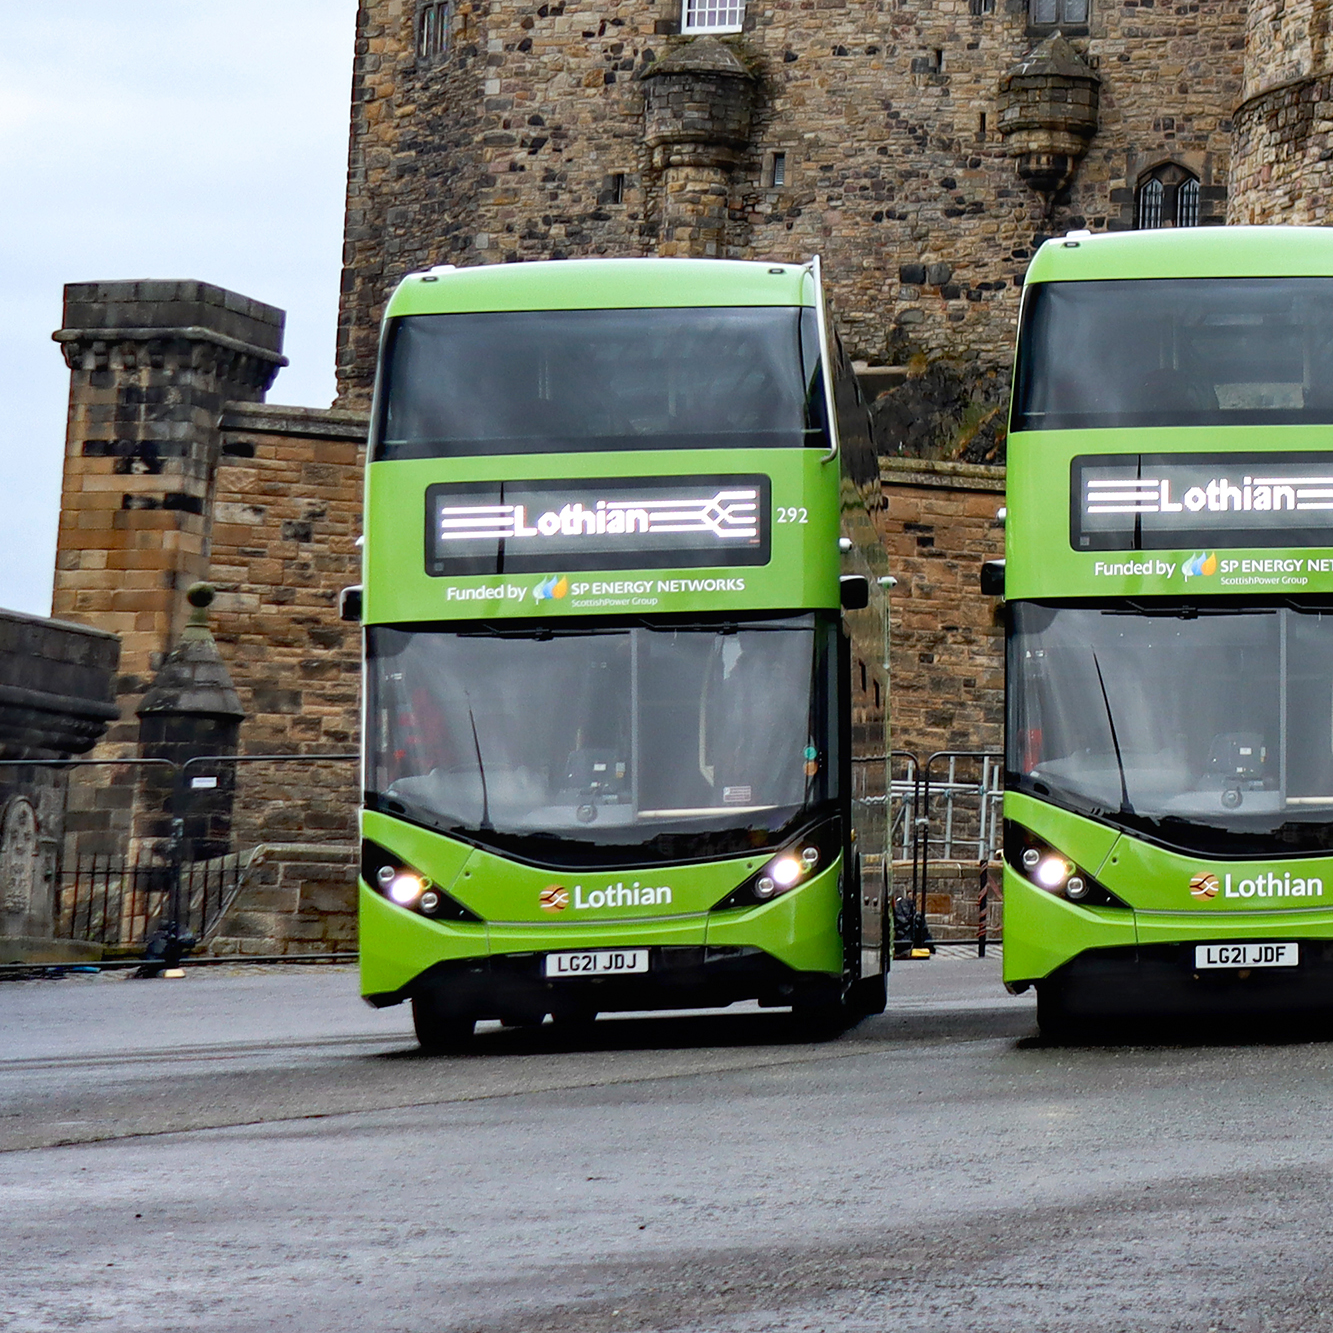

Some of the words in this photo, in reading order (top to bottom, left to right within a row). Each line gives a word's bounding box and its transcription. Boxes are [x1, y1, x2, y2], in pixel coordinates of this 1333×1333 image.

[1160, 476, 1297, 512] Lothian
[514, 499, 651, 538] Lothian
[776, 506, 809, 524] 292
[1094, 559, 1154, 576] Funded
[1155, 559, 1177, 579] by
[1219, 559, 1240, 574] SP
[1241, 558, 1304, 573] ENERGY
[570, 582, 591, 596] SP
[591, 580, 654, 595] ENERGY
[656, 578, 746, 594] NETWORKS
[1220, 576, 1280, 586] ScottishPower
[1281, 576, 1309, 587] Group
[446, 584, 505, 601] Funded
[506, 583, 528, 602] by
[570, 597, 630, 608] ScottishPower
[631, 596, 659, 607] Group
[1224, 871, 1323, 898] Lothian
[574, 881, 672, 910] Lothian
[557, 954, 598, 973] LG21
[602, 952, 637, 971] JDJ
[1206, 946, 1247, 964] LG21
[1252, 945, 1286, 963] JDF
